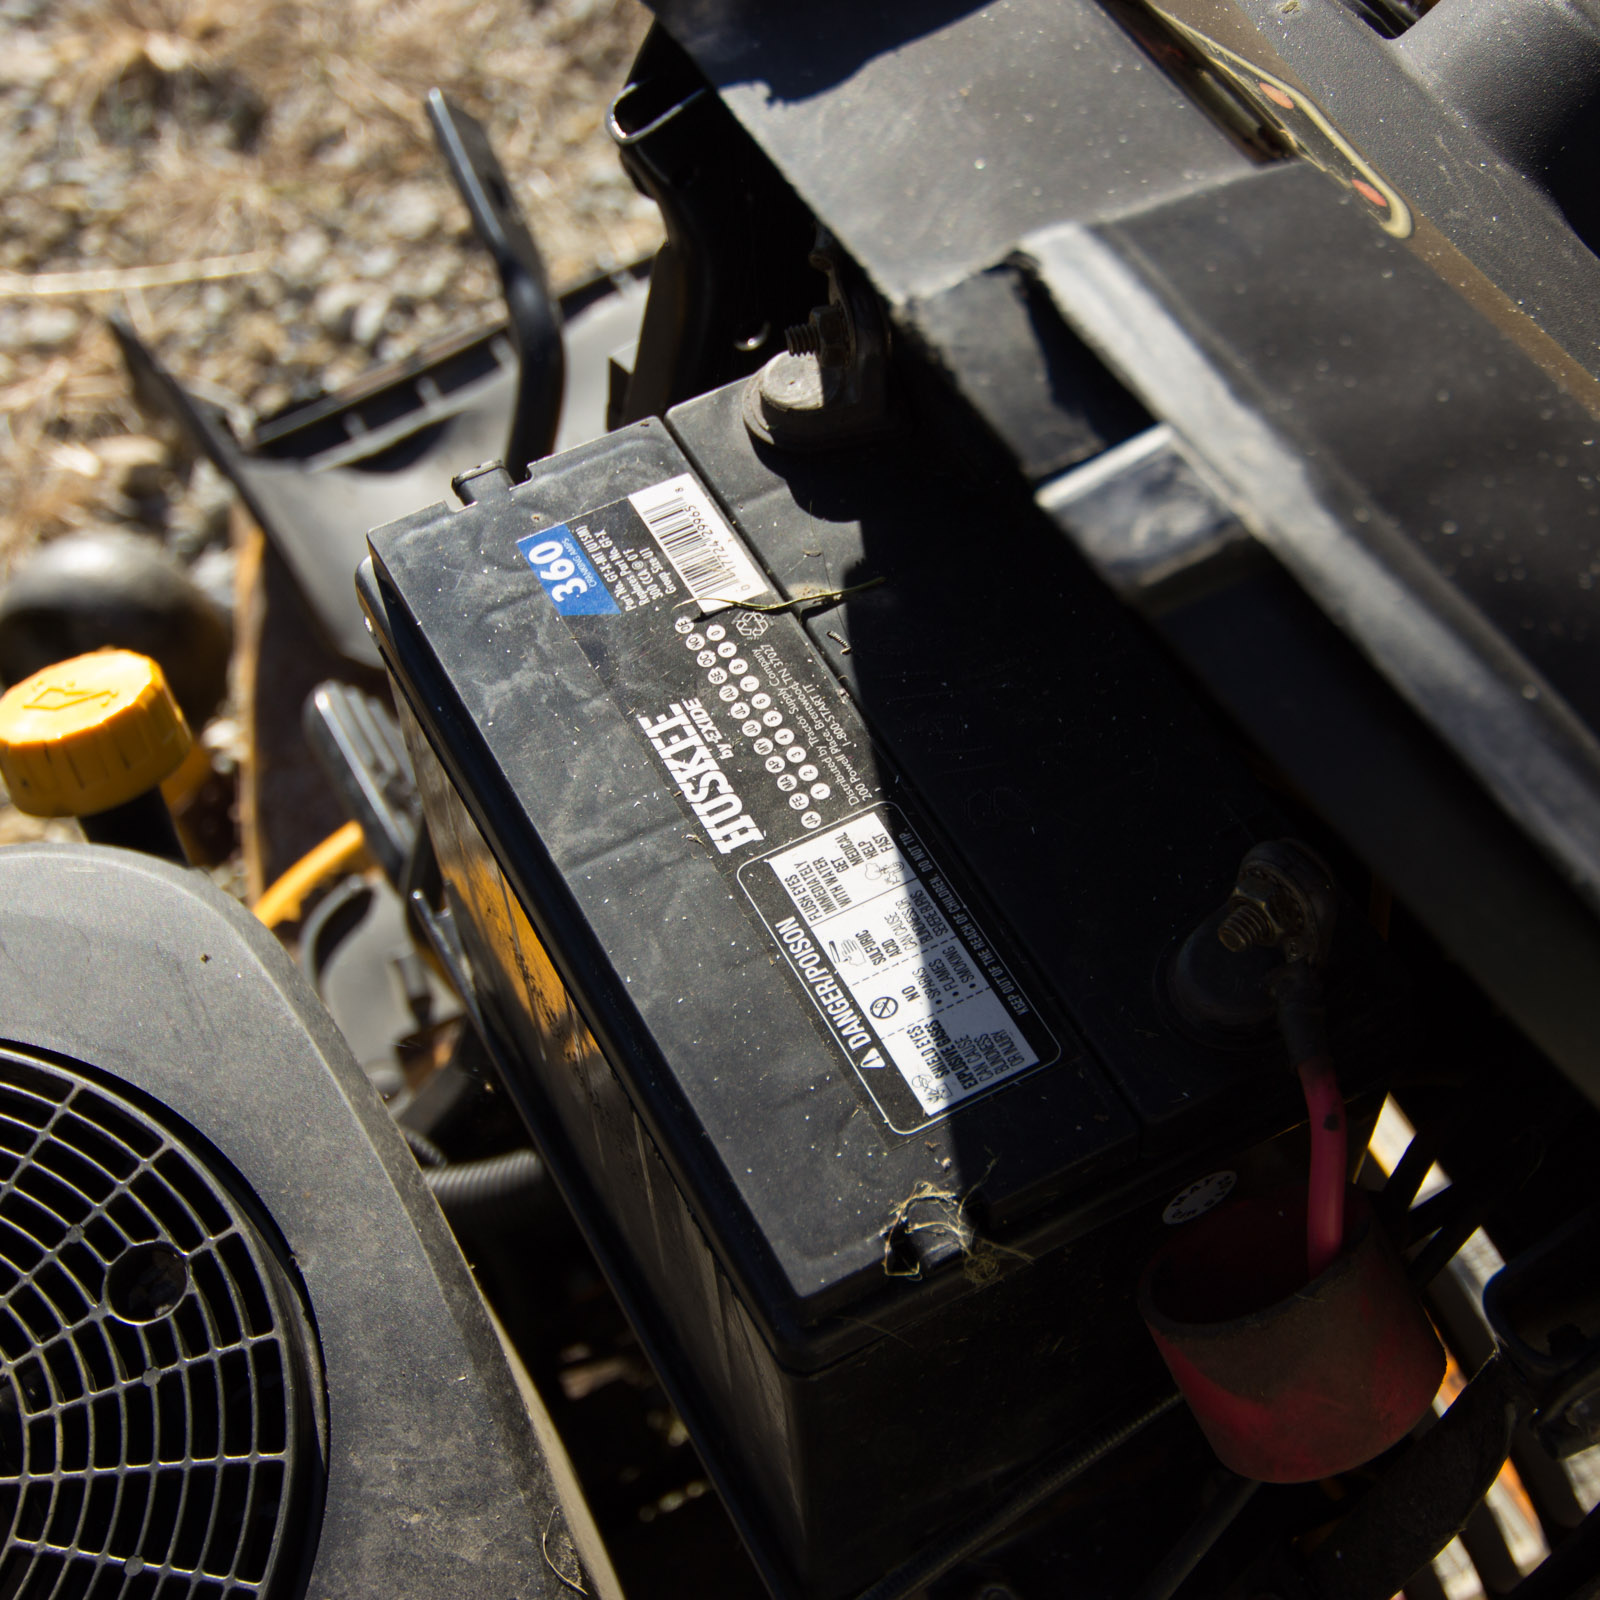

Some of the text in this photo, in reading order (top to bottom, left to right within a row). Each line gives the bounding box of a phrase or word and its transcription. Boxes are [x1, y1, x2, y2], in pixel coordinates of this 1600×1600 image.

[684, 504, 713, 537] 29965
[560, 537, 598, 588] CRANKING AMPS
[574, 524, 638, 612] Part No. GT-X-MT (U1SM)
[593, 528, 652, 606] Replaces Part No. GT-X
[630, 559, 645, 570] @
[708, 539, 736, 572] 17724
[525, 538, 589, 603] 360
[636, 568, 654, 585] CCA
[638, 546, 679, 595] Group Size U1
[645, 583, 664, 600] 300
[740, 583, 751, 591] 0
[688, 636, 702, 649] NO
[759, 642, 784, 669] 37027
[710, 670, 725, 682] SE
[749, 647, 781, 687] Company
[777, 667, 794, 685] TN
[723, 687, 736, 699] AU
[775, 686, 800, 715] Supply
[734, 705, 747, 716] JL
[802, 682, 852, 747] 1-800-START IT
[682, 696, 736, 761] by EXIDE
[745, 723, 759, 734] JU
[794, 714, 820, 747] Tractor
[755, 739, 770, 753] MY
[814, 744, 828, 756] by
[636, 701, 765, 856] HUSKEE
[767, 758, 782, 770] AP
[834, 752, 861, 784] Powell
[779, 775, 794, 790] MA
[820, 755, 860, 806] Distributed
[854, 781, 873, 801] 200
[791, 794, 806, 808] FE
[804, 813, 819, 826] JA
[834, 831, 865, 867] MEDICAL
[857, 839, 879, 860] HELP
[871, 831, 894, 854] FAST
[906, 843, 926, 862] NOT
[830, 855, 850, 873] GET
[917, 859, 933, 873] DO
[793, 859, 838, 915] IMMEDIATELY
[811, 855, 852, 908] WITH WATER
[783, 873, 823, 922] FLUSH EYES
[894, 896, 934, 945] BLINDNESS OR
[908, 888, 949, 938] SEVERE BURNS
[952, 911, 968, 925] OF
[883, 911, 918, 951] CAN CAUSE
[960, 922, 986, 951] REACH
[854, 928, 887, 966] SULFURIC
[880, 937, 903, 958] ACID
[976, 947, 996, 966] THE
[927, 957, 959, 992] FLAMES
[941, 944, 975, 984] SMOKING
[987, 964, 1004, 977] OF
[773, 915, 872, 1050] DANGER/POISON
[900, 984, 921, 1002] NO
[910, 965, 942, 1000] SPARKS
[994, 975, 1015, 994] OUT
[1006, 993, 1029, 1016] KEEP
[905, 1024, 950, 1080] SHIELD EYES
[923, 1018, 979, 1091] EXPLOSIVE GASES
[953, 1033, 995, 1083] CAN CAUSE
[972, 1032, 1010, 1076] BLINDNESS
[989, 1027, 1025, 1068] OR INJURY
